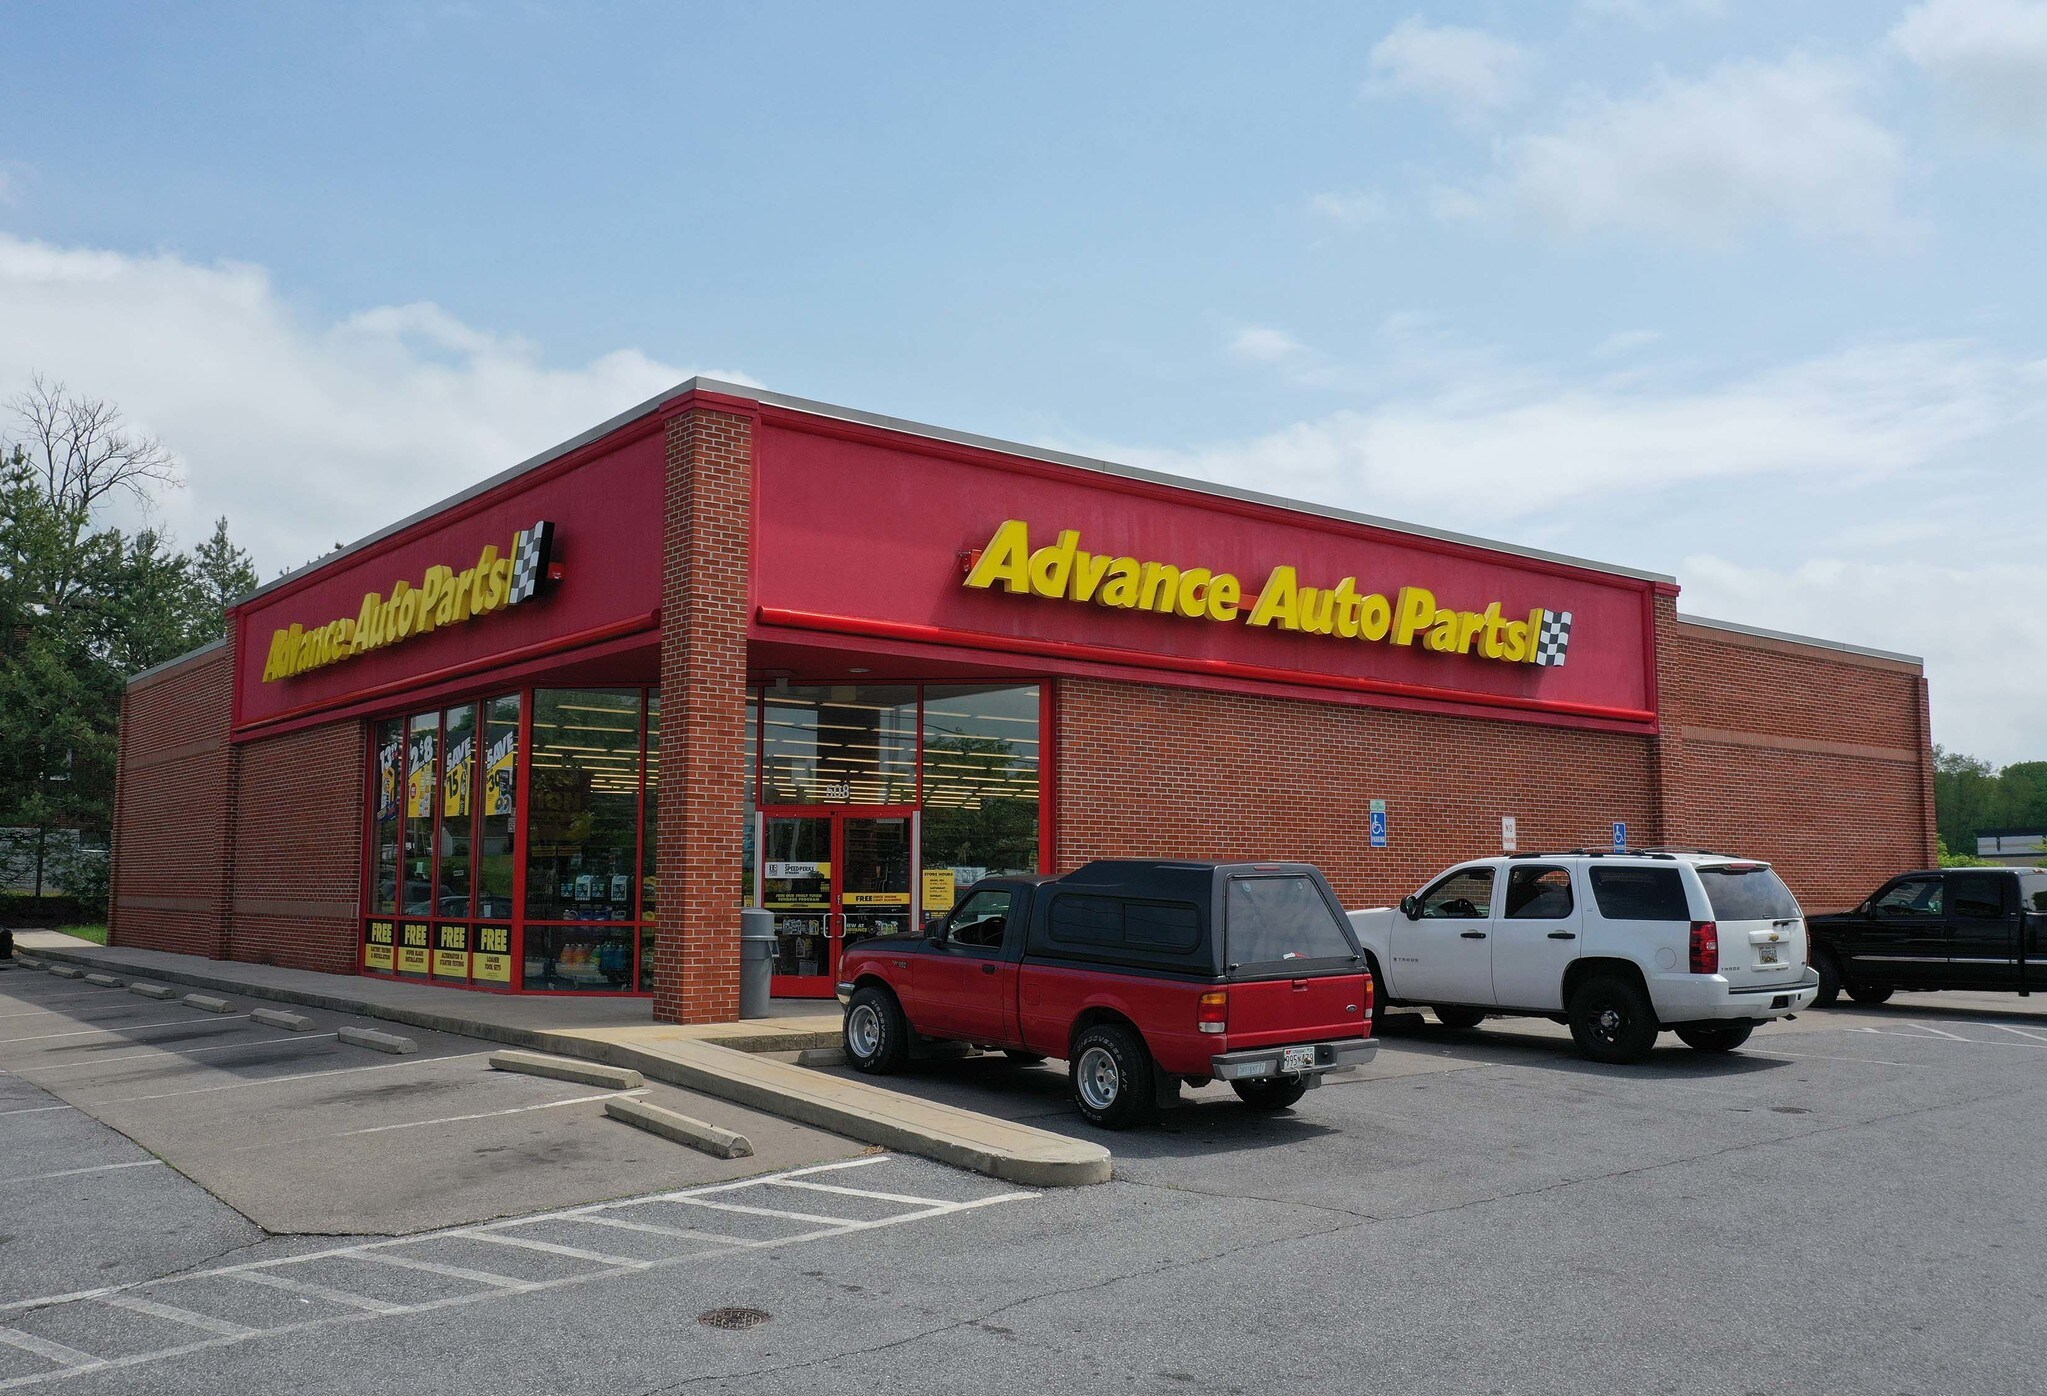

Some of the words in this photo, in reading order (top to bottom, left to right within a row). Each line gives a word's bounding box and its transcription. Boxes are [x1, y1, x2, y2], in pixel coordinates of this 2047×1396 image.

[963, 519, 1241, 621] Advance
[1246, 565, 1391, 642] Auto
[1390, 586, 1528, 664] Parts
[262, 618, 356, 683] Advance
[350, 580, 422, 654] Auto
[416, 544, 510, 633] Parts
[447, 736, 471, 773] SAVE
[486, 731, 513, 770] SAVE
[826, 784, 849, 799] 508
[371, 922, 392, 943] FREE
[404, 924, 427, 946] FREE
[441, 926, 465, 949] FREE
[480, 928, 507, 951] FREE
